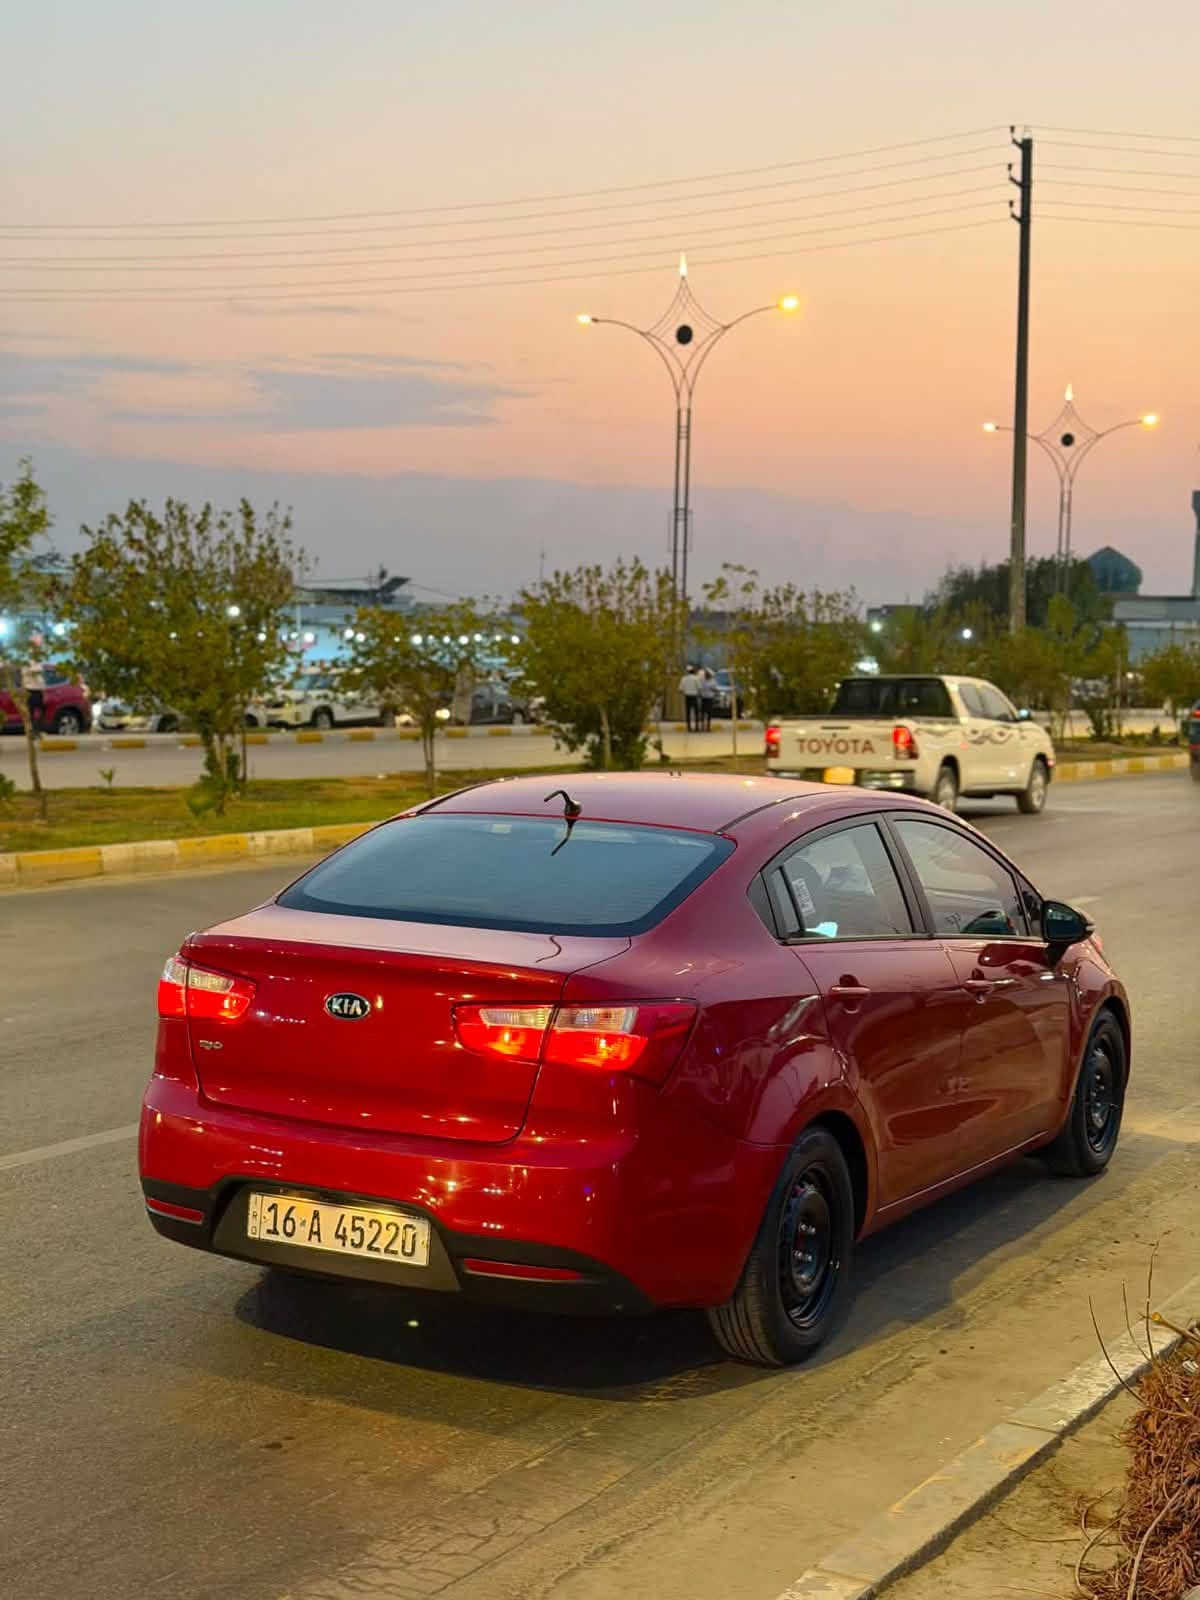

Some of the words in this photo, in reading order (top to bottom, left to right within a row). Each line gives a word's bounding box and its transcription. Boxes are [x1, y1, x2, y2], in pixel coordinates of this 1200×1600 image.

[797, 738, 875, 754] TOYOTA
[331, 997, 362, 1015] KIA
[265, 1202, 297, 1238] 16
[307, 1210, 322, 1243] A
[334, 1213, 417, 1258] 45220
